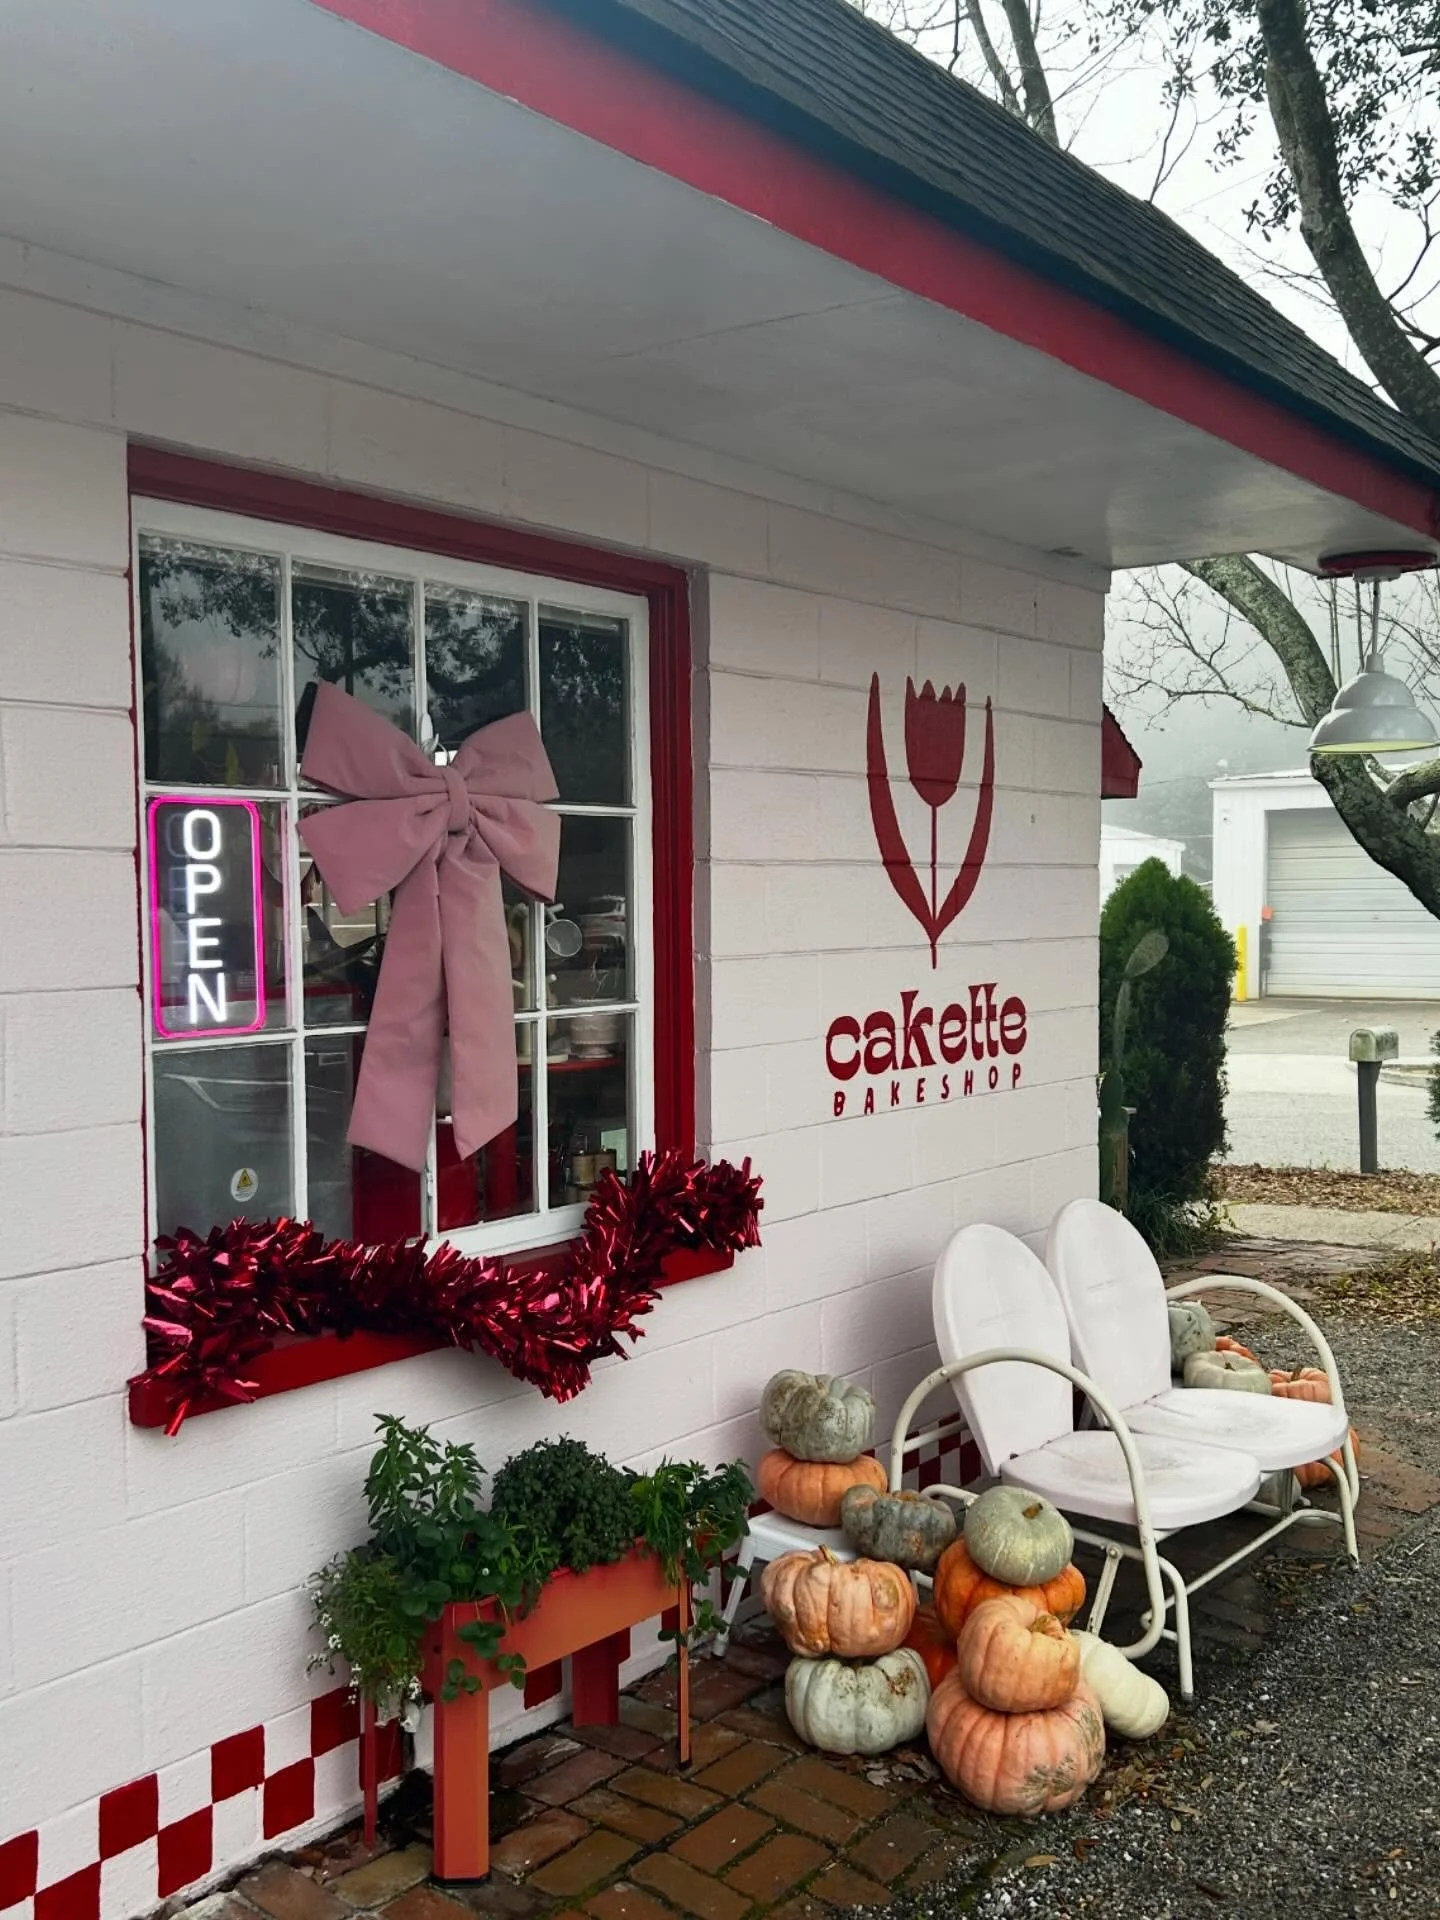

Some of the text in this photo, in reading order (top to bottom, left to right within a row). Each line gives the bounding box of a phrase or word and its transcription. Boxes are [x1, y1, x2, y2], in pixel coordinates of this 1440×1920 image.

[183, 809, 228, 1024] OPEN
[826, 983, 1027, 1081] cakette
[834, 1063, 1021, 1117] BAKESHOP
